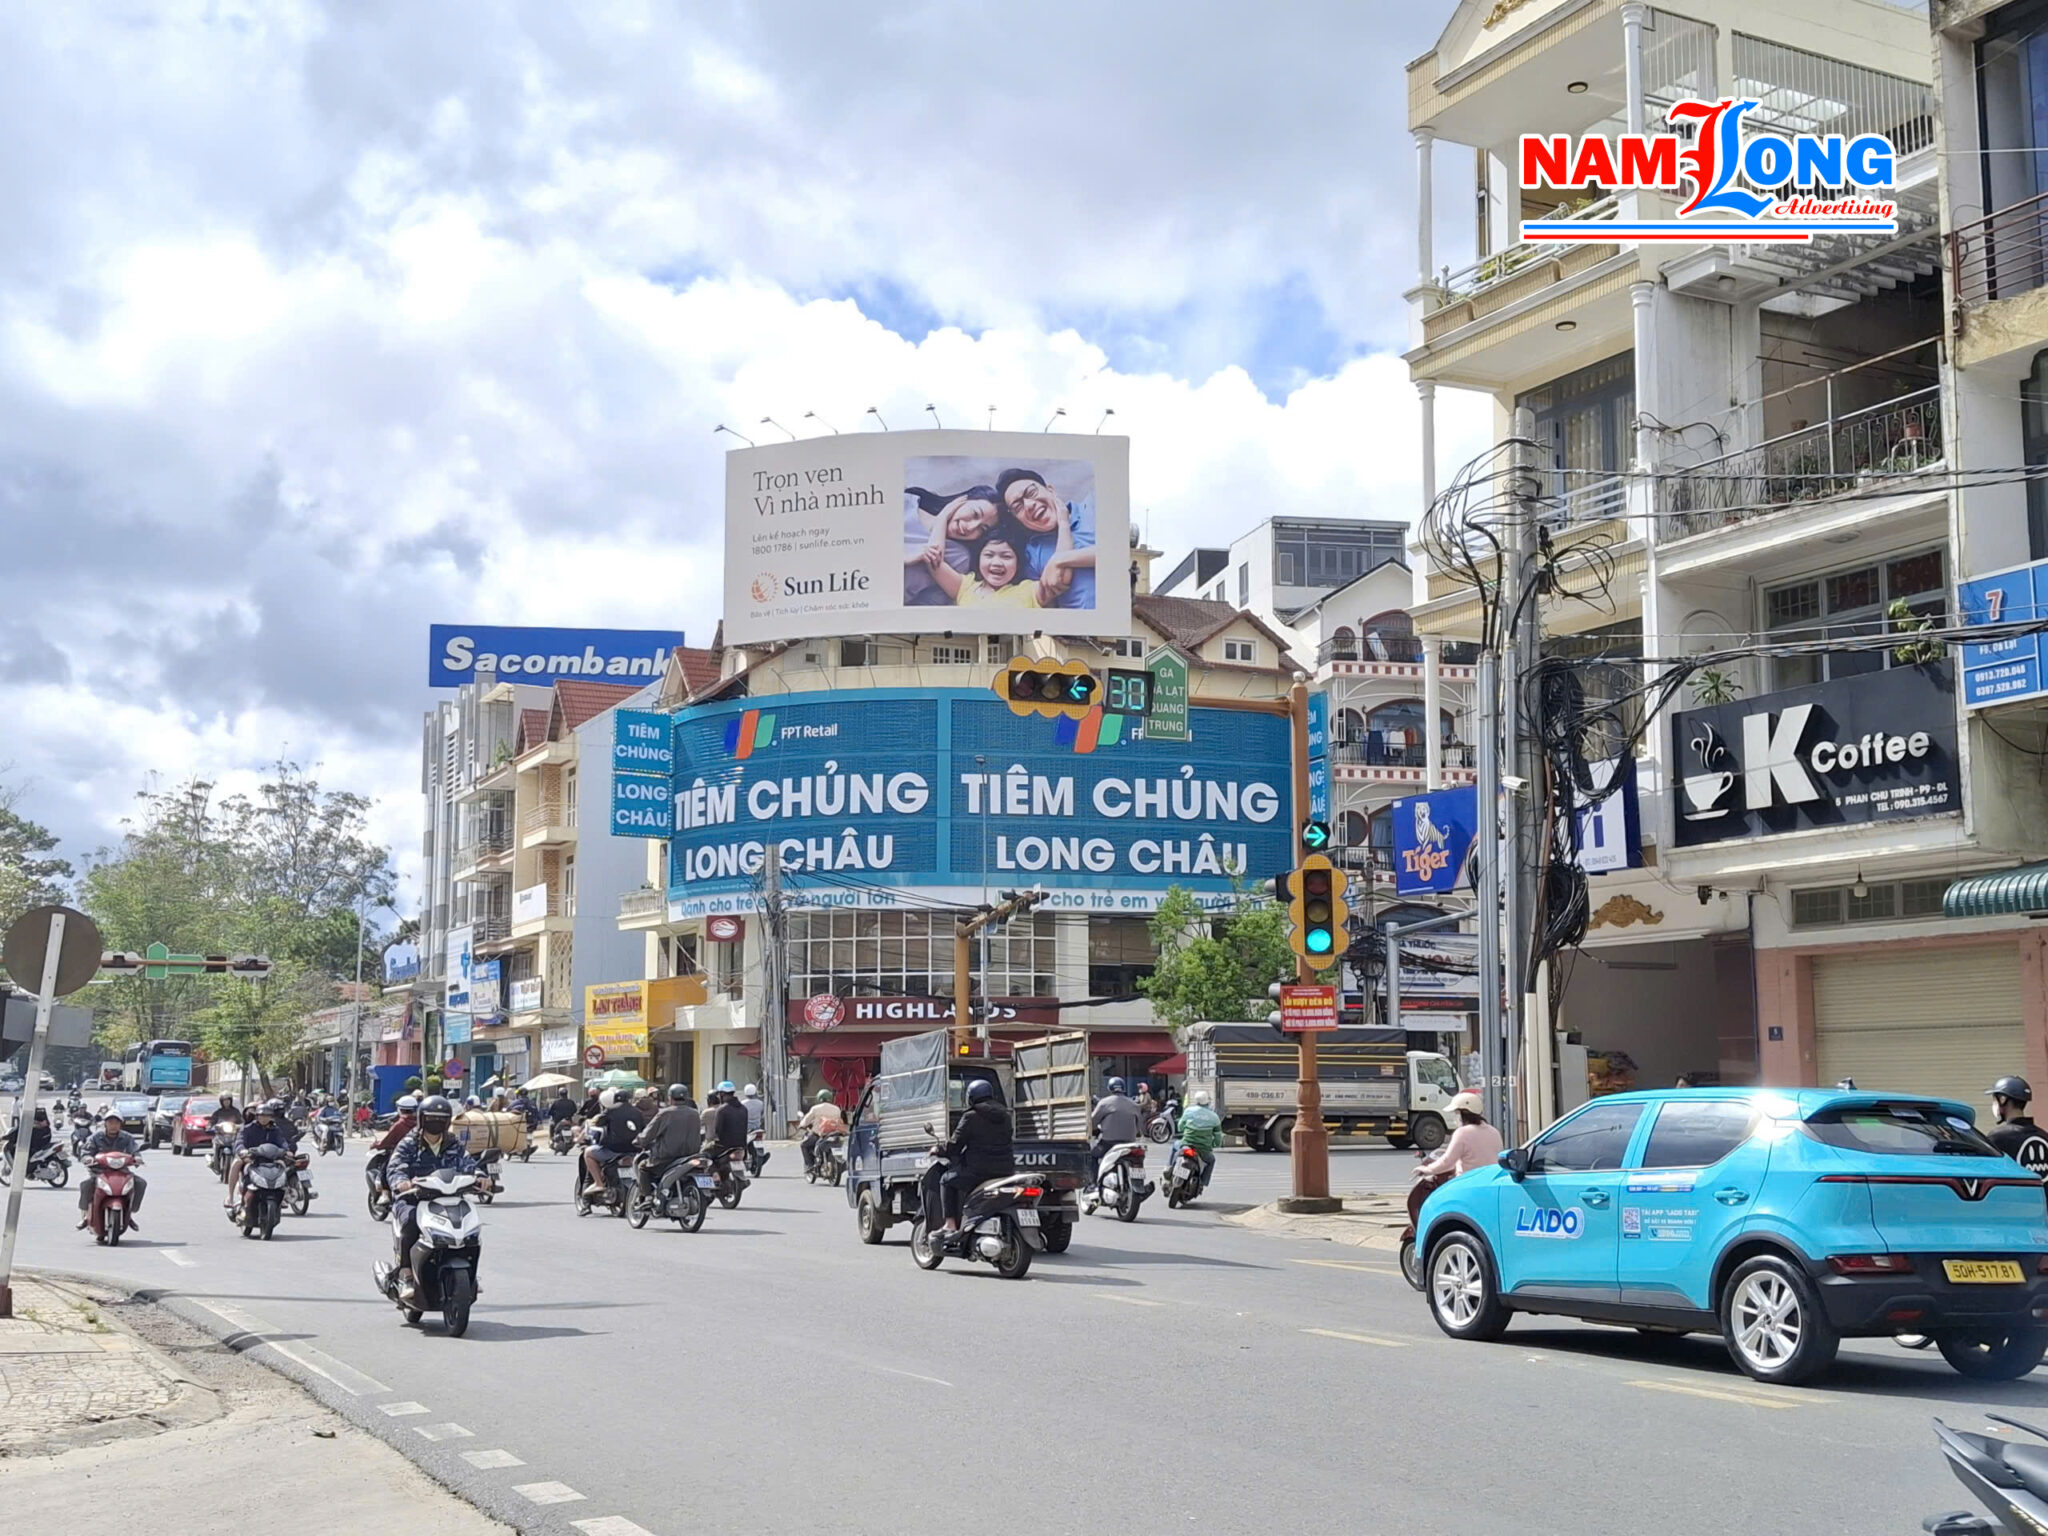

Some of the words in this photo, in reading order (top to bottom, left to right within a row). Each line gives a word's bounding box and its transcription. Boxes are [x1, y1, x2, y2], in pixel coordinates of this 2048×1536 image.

[753, 470, 799, 492] Trọn
[804, 467, 843, 487] vẹn
[753, 495, 775, 516] Vì
[780, 491, 819, 513] nhà
[825, 483, 885, 508] mình
[809, 528, 830, 538] ngay
[752, 545, 772, 555] 1800
[774, 543, 792, 553] 1786
[799, 537, 864, 551] sunlife.com.vn
[784, 576, 823, 597] Sun
[829, 569, 870, 592] Life
[1985, 588, 2003, 621] 7
[443, 636, 672, 676] Sacombank
[1160, 667, 1174, 679] GA
[1110, 675, 1145, 710] 30
[628, 722, 660, 740] TIÊM
[781, 725, 802, 739] FPT
[803, 723, 838, 738] Retail
[1149, 719, 1184, 732] TRUNG
[616, 742, 671, 762] CHỦNG
[1743, 703, 1820, 810] K
[1811, 731, 1930, 774] Coffee
[617, 783, 668, 801] LONG
[674, 777, 736, 831] TIÊM
[748, 760, 929, 820] CHỦNG
[960, 763, 1074, 816] TIÊM
[1092, 765, 1279, 823] CHỦNG
[1845, 793, 1868, 805] PHAN
[615, 807, 668, 827] CHÂU
[685, 840, 765, 881] LONG
[778, 826, 893, 872] CHÂU
[996, 836, 1115, 873] LONG
[1128, 832, 1247, 876] CHÂU
[1402, 843, 1450, 882] Tiger
[709, 898, 732, 914] cho
[1050, 892, 1084, 907] cho
[1122, 894, 1148, 909] em
[856, 1002, 1016, 1019] HIGHLADS
[1013, 1153, 1056, 1165] ZUKI
[1517, 1208, 1578, 1233] LADO
[1952, 1264, 2016, 1279] 50H-517.81
